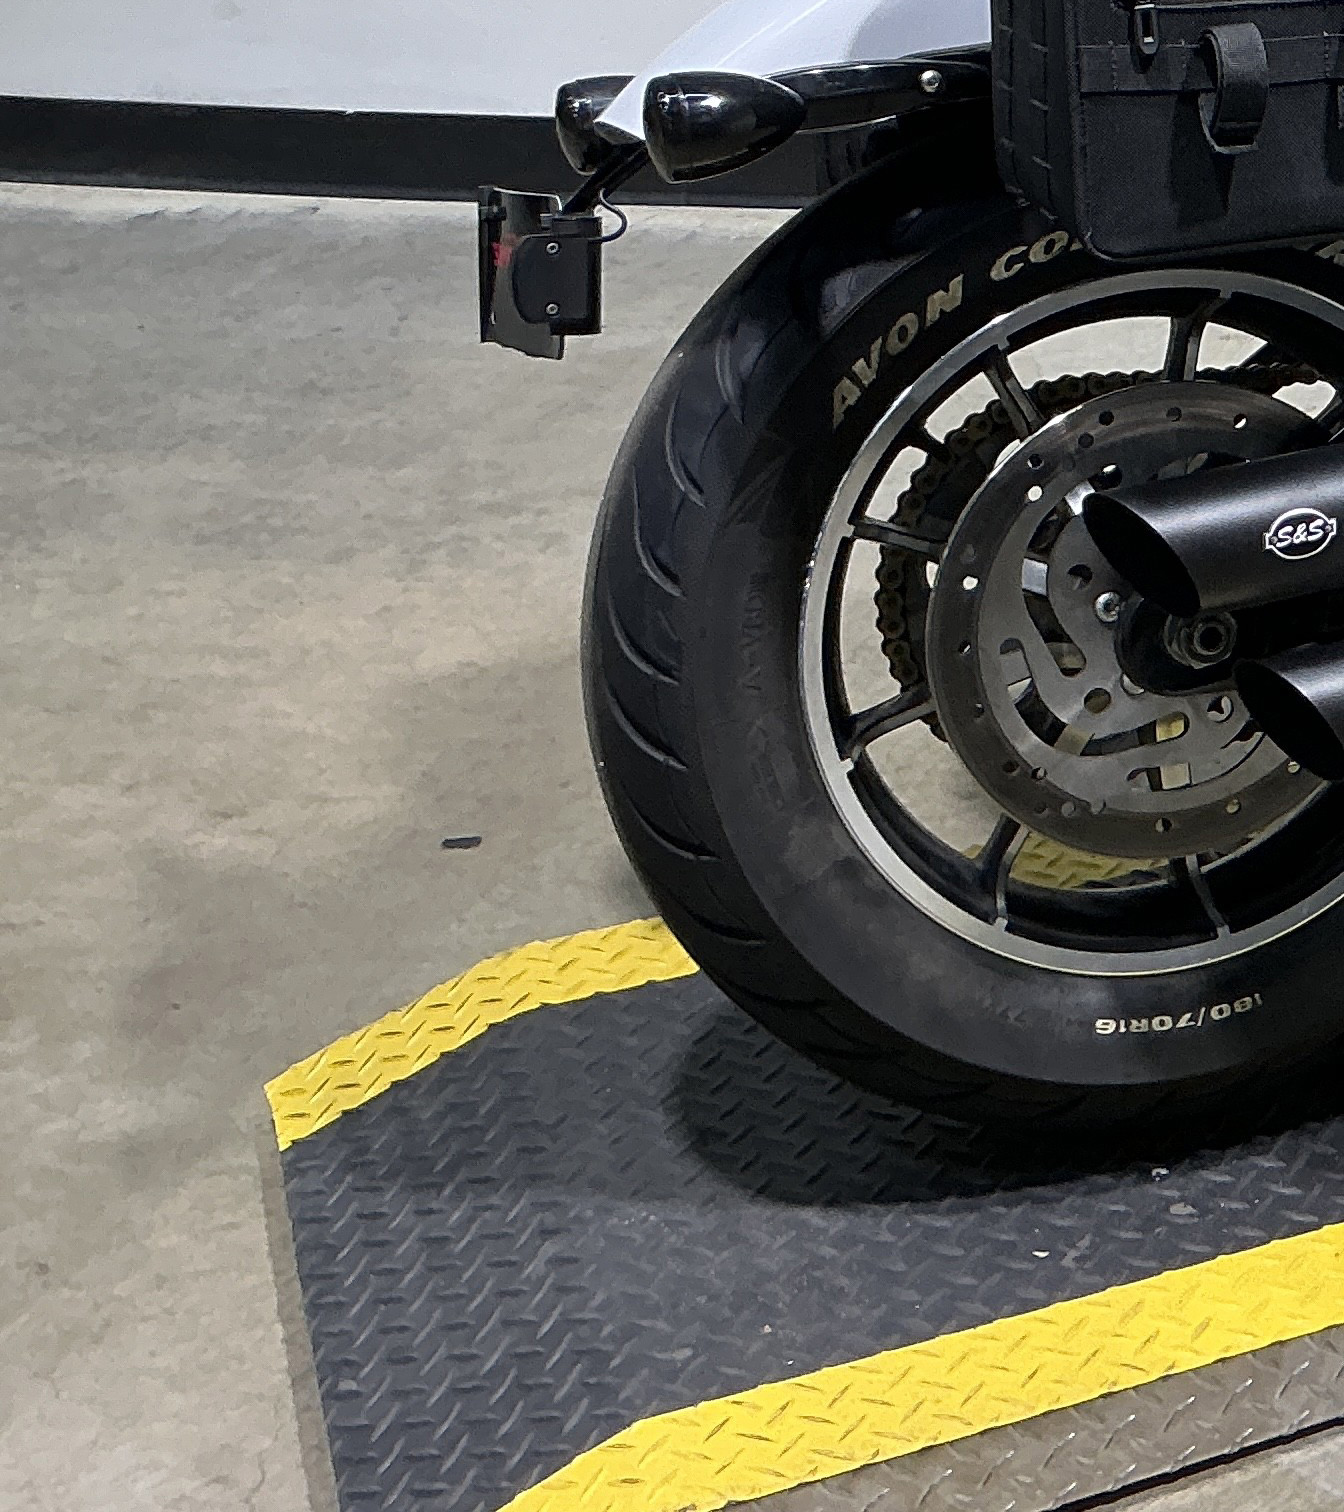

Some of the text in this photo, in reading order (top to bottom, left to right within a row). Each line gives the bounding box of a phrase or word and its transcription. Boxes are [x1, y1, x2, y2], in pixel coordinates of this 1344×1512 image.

[833, 272, 965, 430] AVON
[989, 230, 1084, 282] CO
[1275, 518, 1325, 548] S&S
[1094, 992, 1263, 1035] 180/70R16
